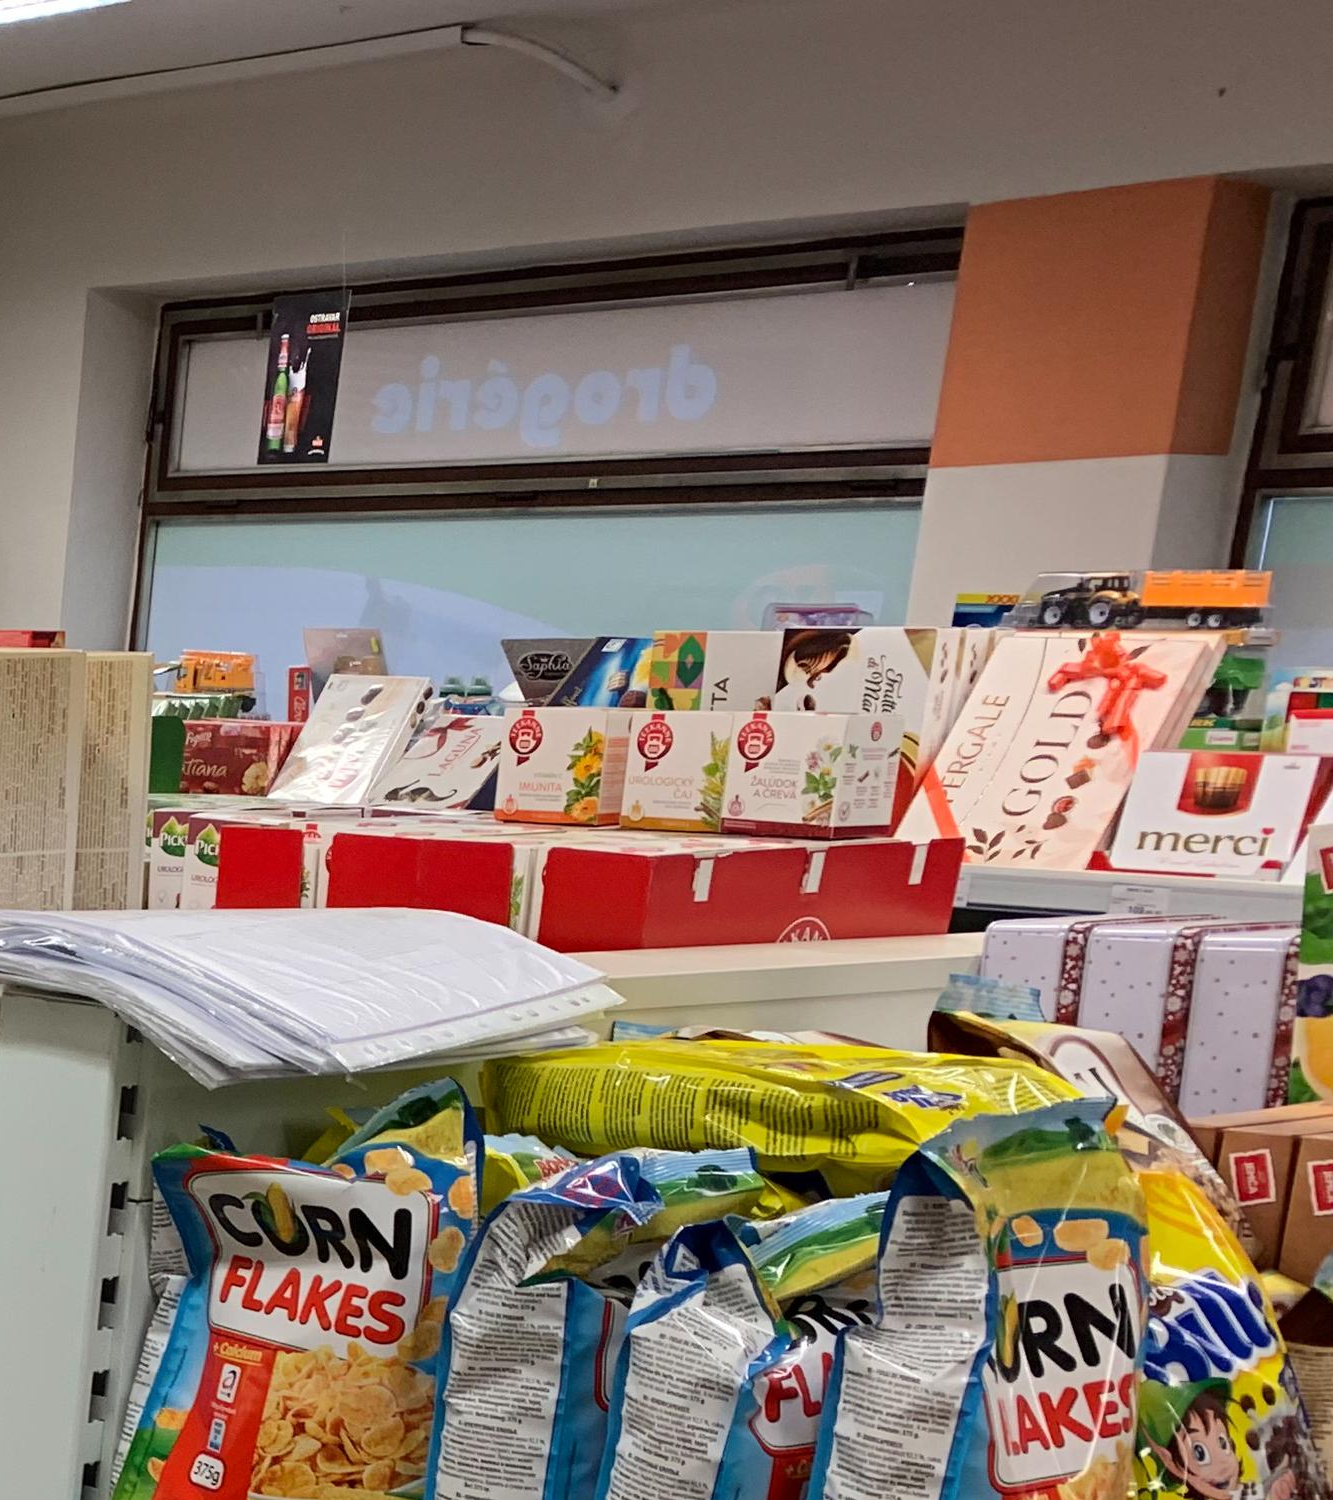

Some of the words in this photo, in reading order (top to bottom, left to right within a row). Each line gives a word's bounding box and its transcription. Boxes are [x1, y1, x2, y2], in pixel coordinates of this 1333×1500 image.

[1002, 690, 1094, 817] GOLD
[519, 781, 562, 793] IMUNITA
[629, 775, 694, 787] UROLOGICKÝ
[159, 831, 189, 848] PICK
[195, 838, 220, 856] PIC
[1135, 827, 1275, 858] merci
[207, 1182, 412, 1281] CORN
[218, 1254, 406, 1345] FLAKES
[988, 1282, 1137, 1385] ORN
[763, 1351, 832, 1424] FL
[1003, 1372, 1135, 1458] LAKES
[192, 1456, 221, 1485] 375g
